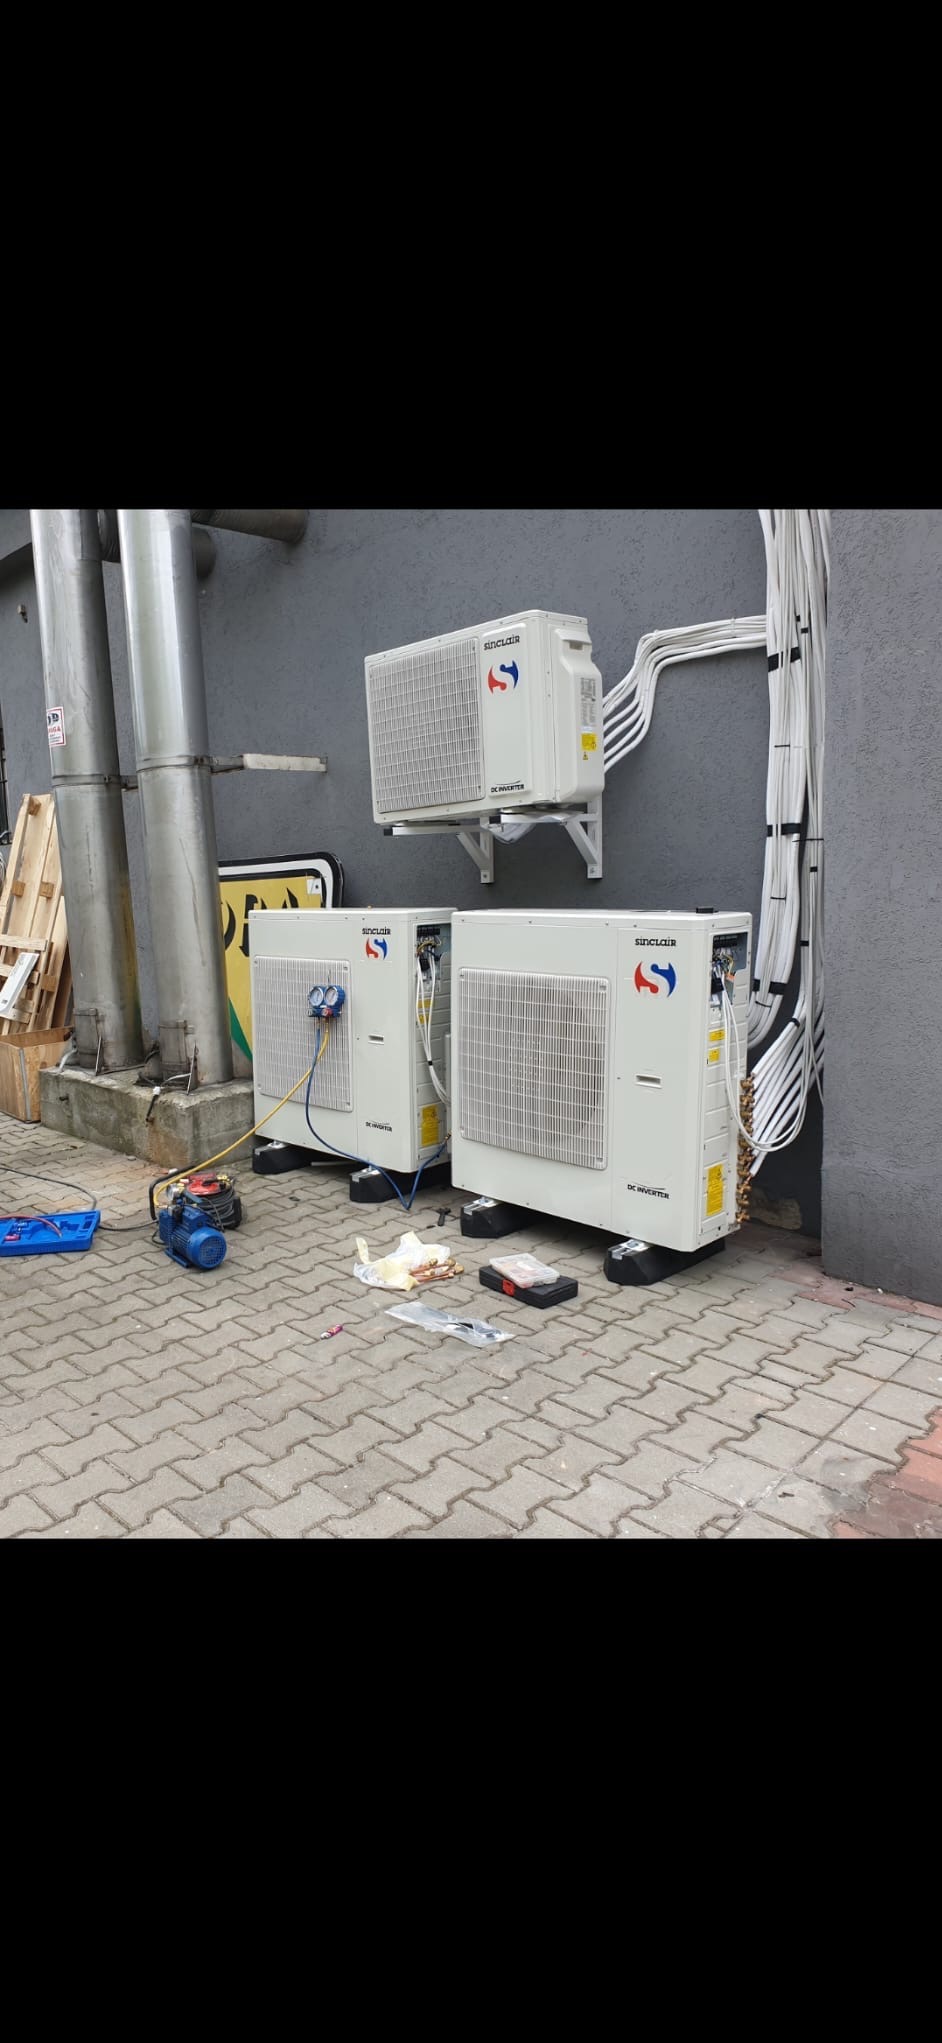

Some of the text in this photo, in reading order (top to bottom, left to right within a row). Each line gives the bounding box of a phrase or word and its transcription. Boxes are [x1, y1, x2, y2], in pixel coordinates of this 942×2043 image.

[499, 784, 525, 792] INVERTER
[627, 1183, 670, 1199] DC INVERTER
